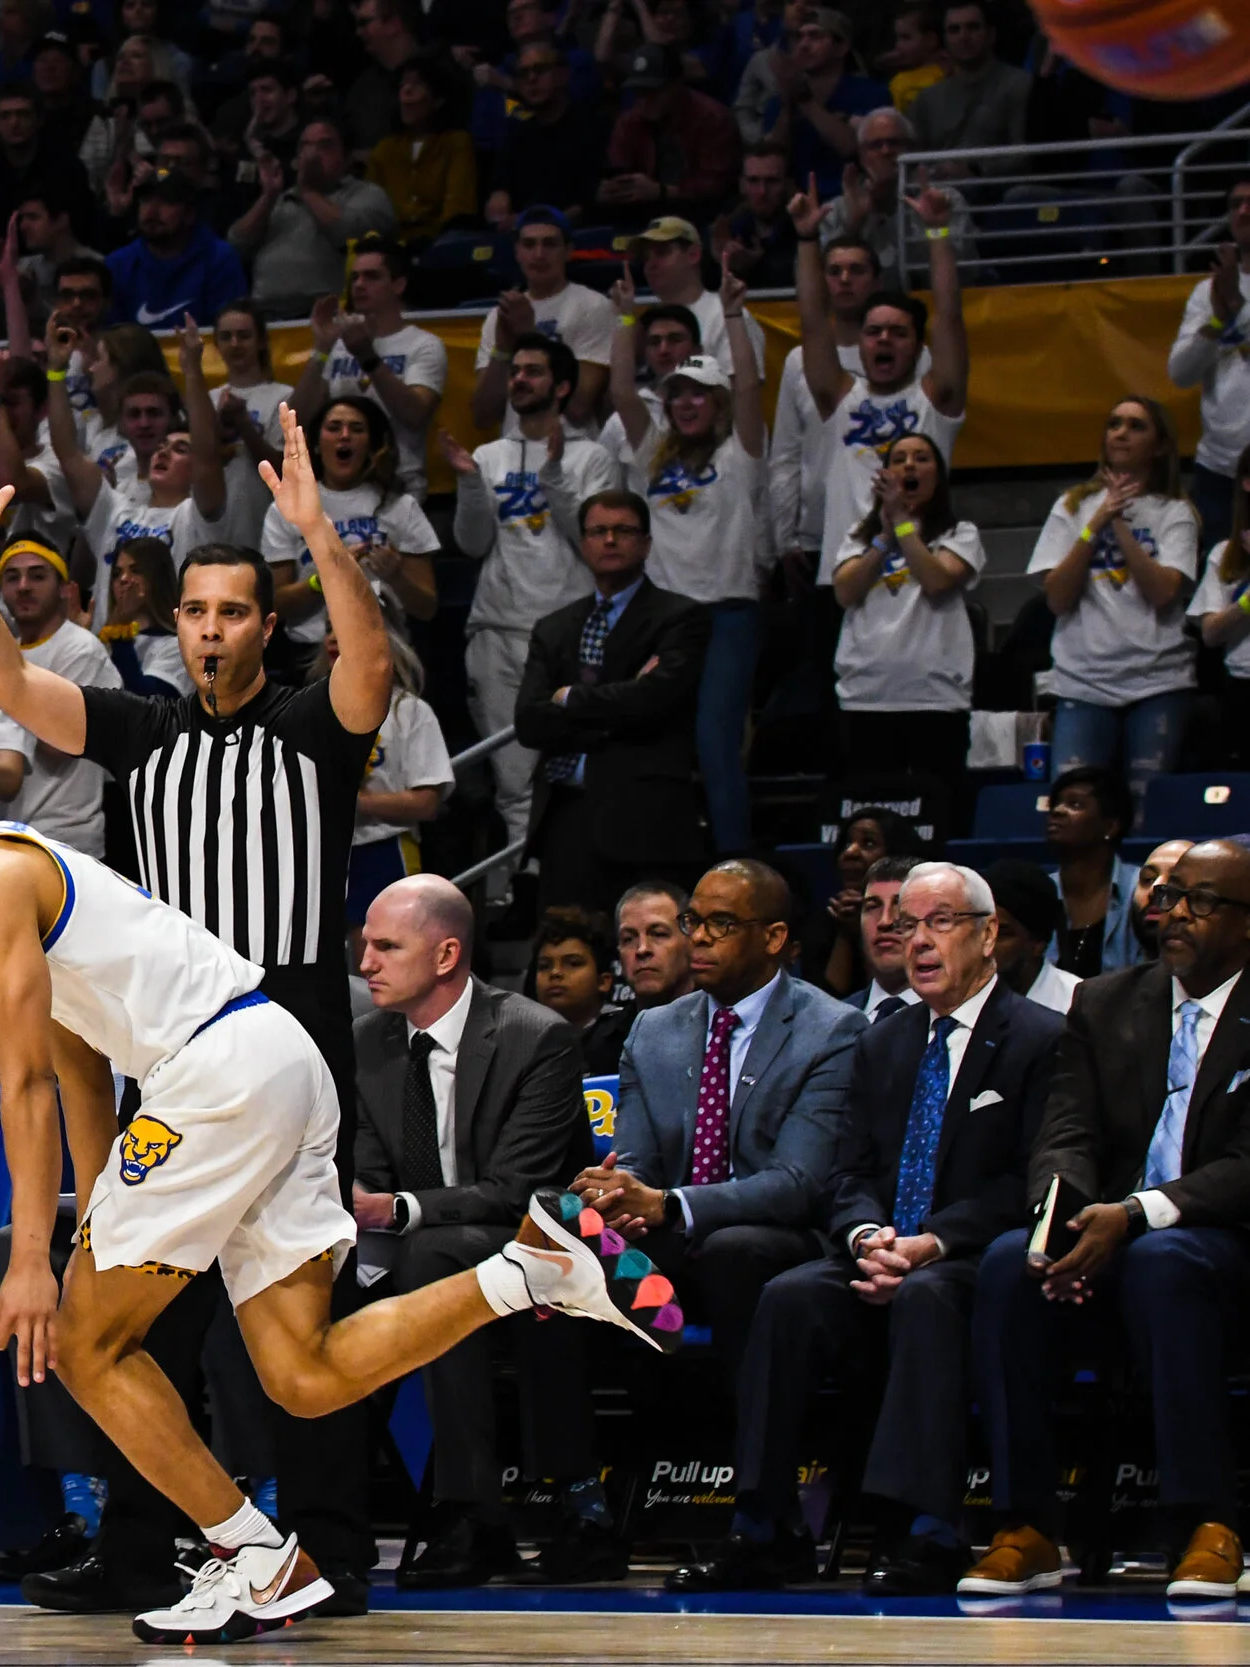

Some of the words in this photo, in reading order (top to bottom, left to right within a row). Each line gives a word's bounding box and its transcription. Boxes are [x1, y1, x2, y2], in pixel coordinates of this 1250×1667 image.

[651, 1461, 701, 1483] Pull
[701, 1465, 735, 1488] up
[797, 1458, 829, 1484] air
[644, 1488, 671, 1508] You
[672, 1494, 691, 1504] are
